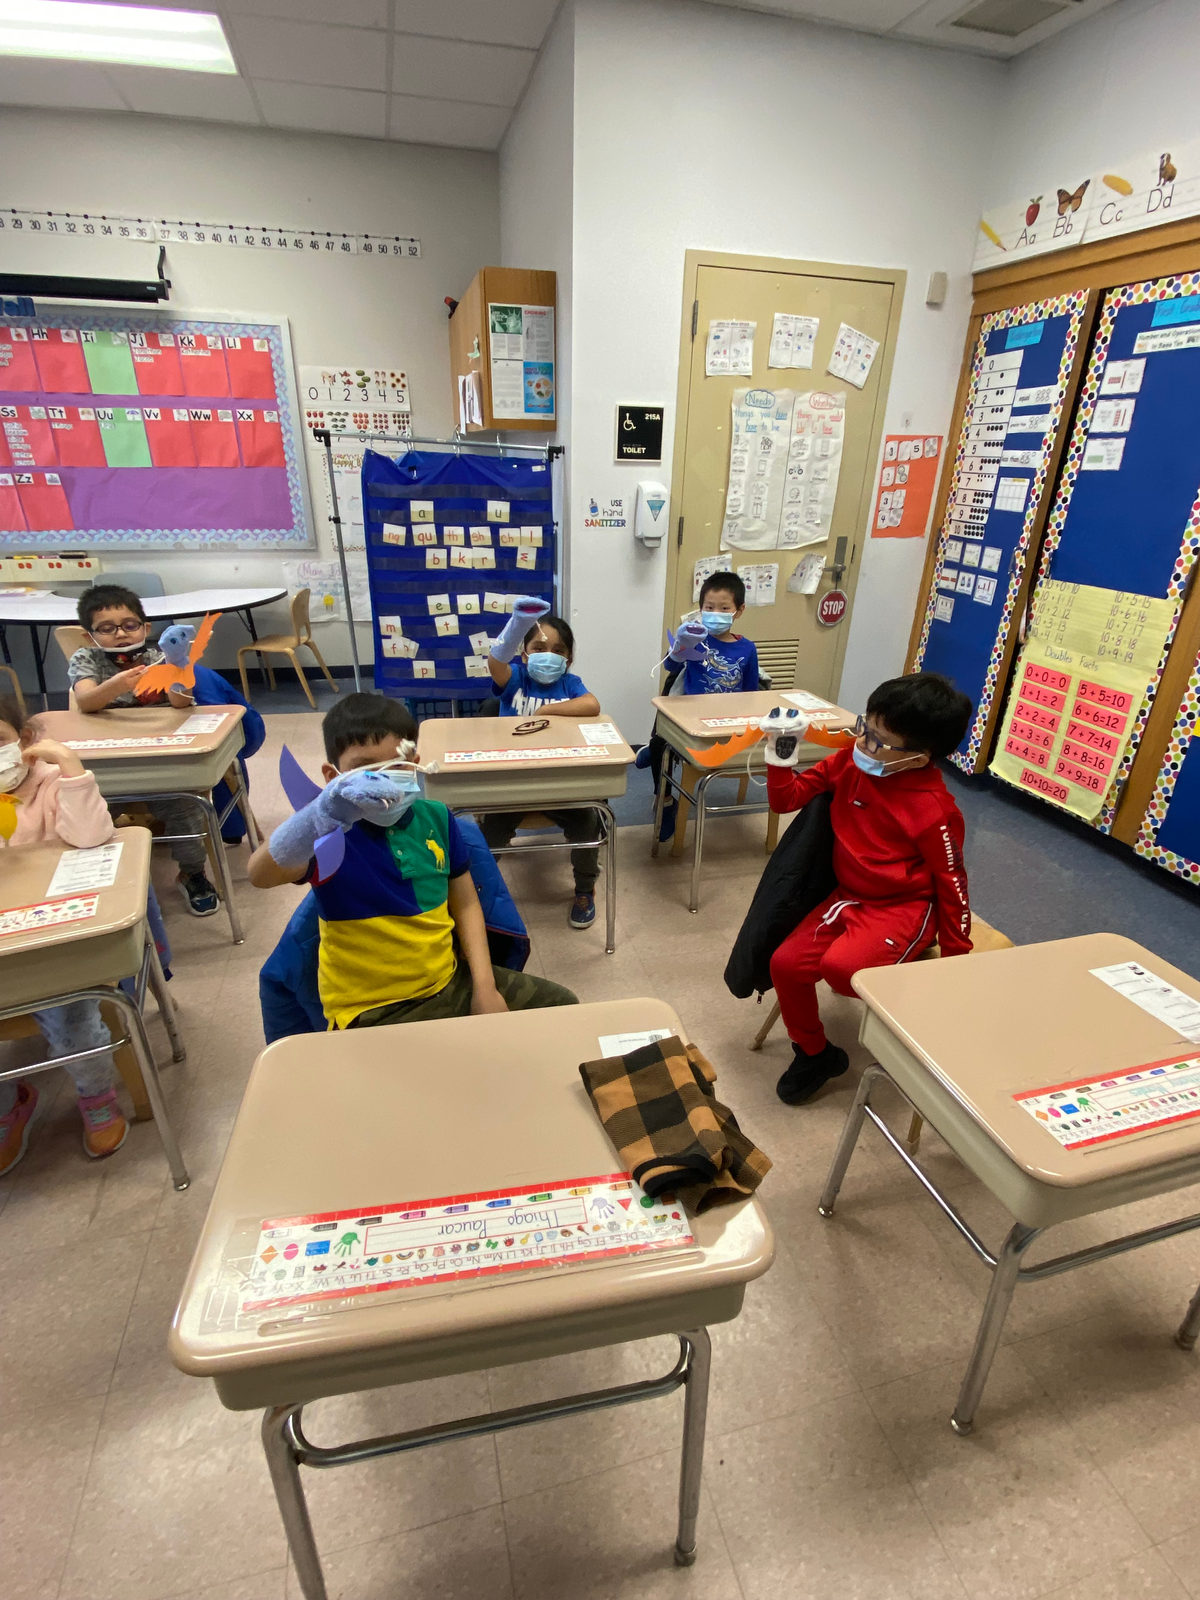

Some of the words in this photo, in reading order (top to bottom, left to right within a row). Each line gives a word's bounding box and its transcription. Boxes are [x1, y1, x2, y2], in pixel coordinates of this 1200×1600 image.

[1015, 228, 1036, 249] Aa
[1053, 214, 1073, 238] Bb
[1100, 202, 1123, 225] Cc
[1147, 184, 1175, 214] Dd
[12, 219, 22, 228] 29
[29, 220, 41, 230] 30
[47, 221, 58, 231] 31
[65, 222, 76, 232] 32
[83, 224, 94, 234] 33
[101, 225, 112, 235] 34
[119, 227, 130, 237] 35
[136, 228, 147, 238] 36
[160, 230, 170, 239] 37
[178, 231, 188, 240] 38
[194, 232, 205, 242] 39
[212, 233, 222, 243] 40
[228, 235, 237, 244] 41
[244, 236, 255, 245] 42
[261, 237, 271, 246] 43
[277, 238, 287, 248] 44
[293, 239, 303, 249] 45
[309, 240, 319, 250] 46
[325, 241, 334, 251] 47
[341, 242, 350, 252] 48
[363, 243, 372, 253] 49
[378, 244, 387, 254] 50
[393, 245, 402, 255] 51
[408, 246, 418, 256] 52
[32, 329, 48, 339] Hh
[82, 332, 94, 342] Ii
[130, 333, 144, 346] Jj
[180, 336, 194, 346] Kk
[989, 360, 994, 370] 0
[986, 377, 990, 387] 1
[308, 387, 318, 400] 0
[328, 387, 332, 400] 1
[343, 388, 351, 401] 2
[361, 389, 368, 402] 3
[379, 389, 386, 402] 4
[397, 390, 404, 403] 5
[748, 393, 771, 405] Needs
[982, 395, 987, 404] 2
[0, 407, 16, 417] Ss
[48, 408, 64, 417] Tt
[97, 410, 113, 420] Uu
[144, 410, 159, 419] Vv
[190, 410, 211, 420] Ww
[237, 411, 252, 420] Xx
[979, 412, 984, 422] 3
[976, 429, 980, 438] 4
[972, 444, 976, 454] 5
[969, 461, 973, 471] 6
[16, 474, 32, 483] Zz
[966, 478, 970, 487] 7
[962, 494, 967, 503] 8
[418, 510, 425, 518] a
[495, 510, 502, 518] u
[603, 508, 623, 516] hand
[959, 510, 964, 519] 9
[585, 519, 626, 527] SANITIZER
[388, 532, 399, 544] ng
[418, 531, 432, 543] qu
[447, 530, 458, 540] th
[472, 530, 485, 541] sh
[501, 532, 513, 543] ch
[433, 554, 440, 565] b
[458, 552, 465, 563] k
[482, 556, 487, 565] r
[492, 600, 498, 608] c
[1114, 592, 1124, 603] 10
[1130, 595, 1138, 605] 5
[1142, 597, 1151, 608] 15
[822, 601, 844, 615] STOP
[1110, 604, 1118, 616] 10
[1124, 608, 1131, 619] 6
[1137, 610, 1146, 622] 16
[443, 621, 450, 631] t
[1106, 618, 1114, 629] 10
[1122, 622, 1127, 633] 7
[1134, 624, 1144, 637] 17
[1101, 632, 1110, 643] 10
[1115, 636, 1121, 646] 8
[1128, 638, 1137, 649] 18
[392, 643, 397, 654] f
[1098, 645, 1106, 655] 10
[1112, 648, 1118, 659] 9
[1124, 651, 1133, 663] 19
[1045, 646, 1072, 663] Doubles
[1080, 656, 1098, 670] Facts
[422, 667, 428, 678] p
[1026, 666, 1033, 676] 0
[1042, 672, 1049, 682] 0
[1059, 678, 1066, 688] 0
[1080, 684, 1087, 695] 5
[1022, 686, 1026, 695] 1
[1035, 690, 1040, 700] 1
[1050, 696, 1058, 706] 2
[1016, 705, 1023, 715] 2
[1032, 712, 1039, 721] 2
[1048, 717, 1055, 727] 4
[1075, 706, 1081, 716] 6
[1011, 723, 1017, 732] 3
[1027, 730, 1032, 739] 3
[1043, 736, 1049, 746] 6
[1069, 725, 1076, 736] 7
[1007, 741, 1013, 750] 4
[1022, 747, 1028, 757] 4
[1038, 754, 1045, 764] 8
[1064, 745, 1070, 755] 8
[1058, 762, 1064, 773] 9
[508, 1208, 563, 1228] Thiago
[438, 1219, 487, 1239] Paucar
